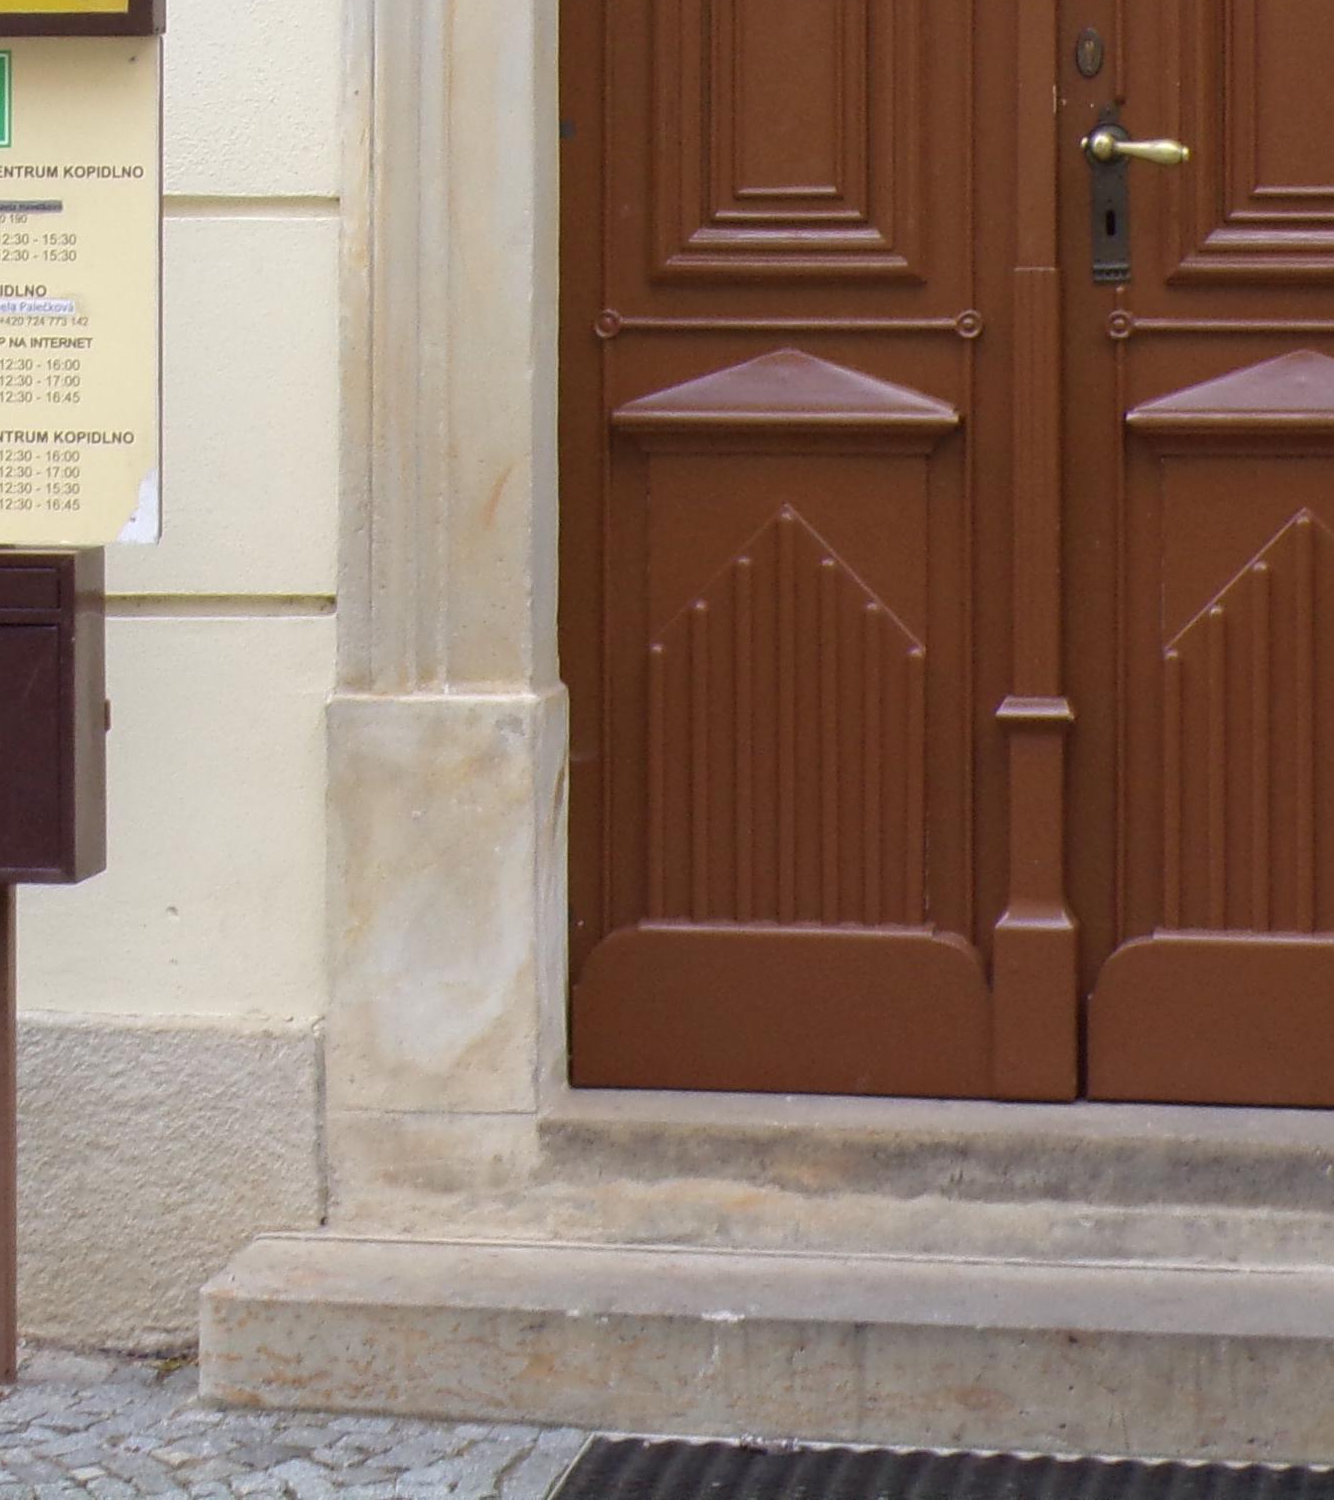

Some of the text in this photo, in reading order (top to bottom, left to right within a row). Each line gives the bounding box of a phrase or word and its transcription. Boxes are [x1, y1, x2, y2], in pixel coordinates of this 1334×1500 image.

[64, 166, 143, 178] KOPIDLNO
[43, 233, 76, 245] 15:30
[43, 250, 76, 261] 15:30
[9, 337, 26, 348] NA
[31, 337, 93, 348] INTERNET
[0, 359, 33, 370] 12:30
[47, 359, 80, 371] 16:00
[0, 375, 32, 386] 12:30
[47, 375, 80, 387] 17:00
[0, 391, 32, 403] 12:30
[47, 391, 80, 403] 16:45
[54, 431, 134, 444] KOPIDLNO
[46, 450, 80, 462] 16:00
[0, 466, 32, 478] 12:30
[46, 466, 80, 478] 17:00
[47, 482, 80, 494] 15:30
[46, 499, 80, 510] 16:45
